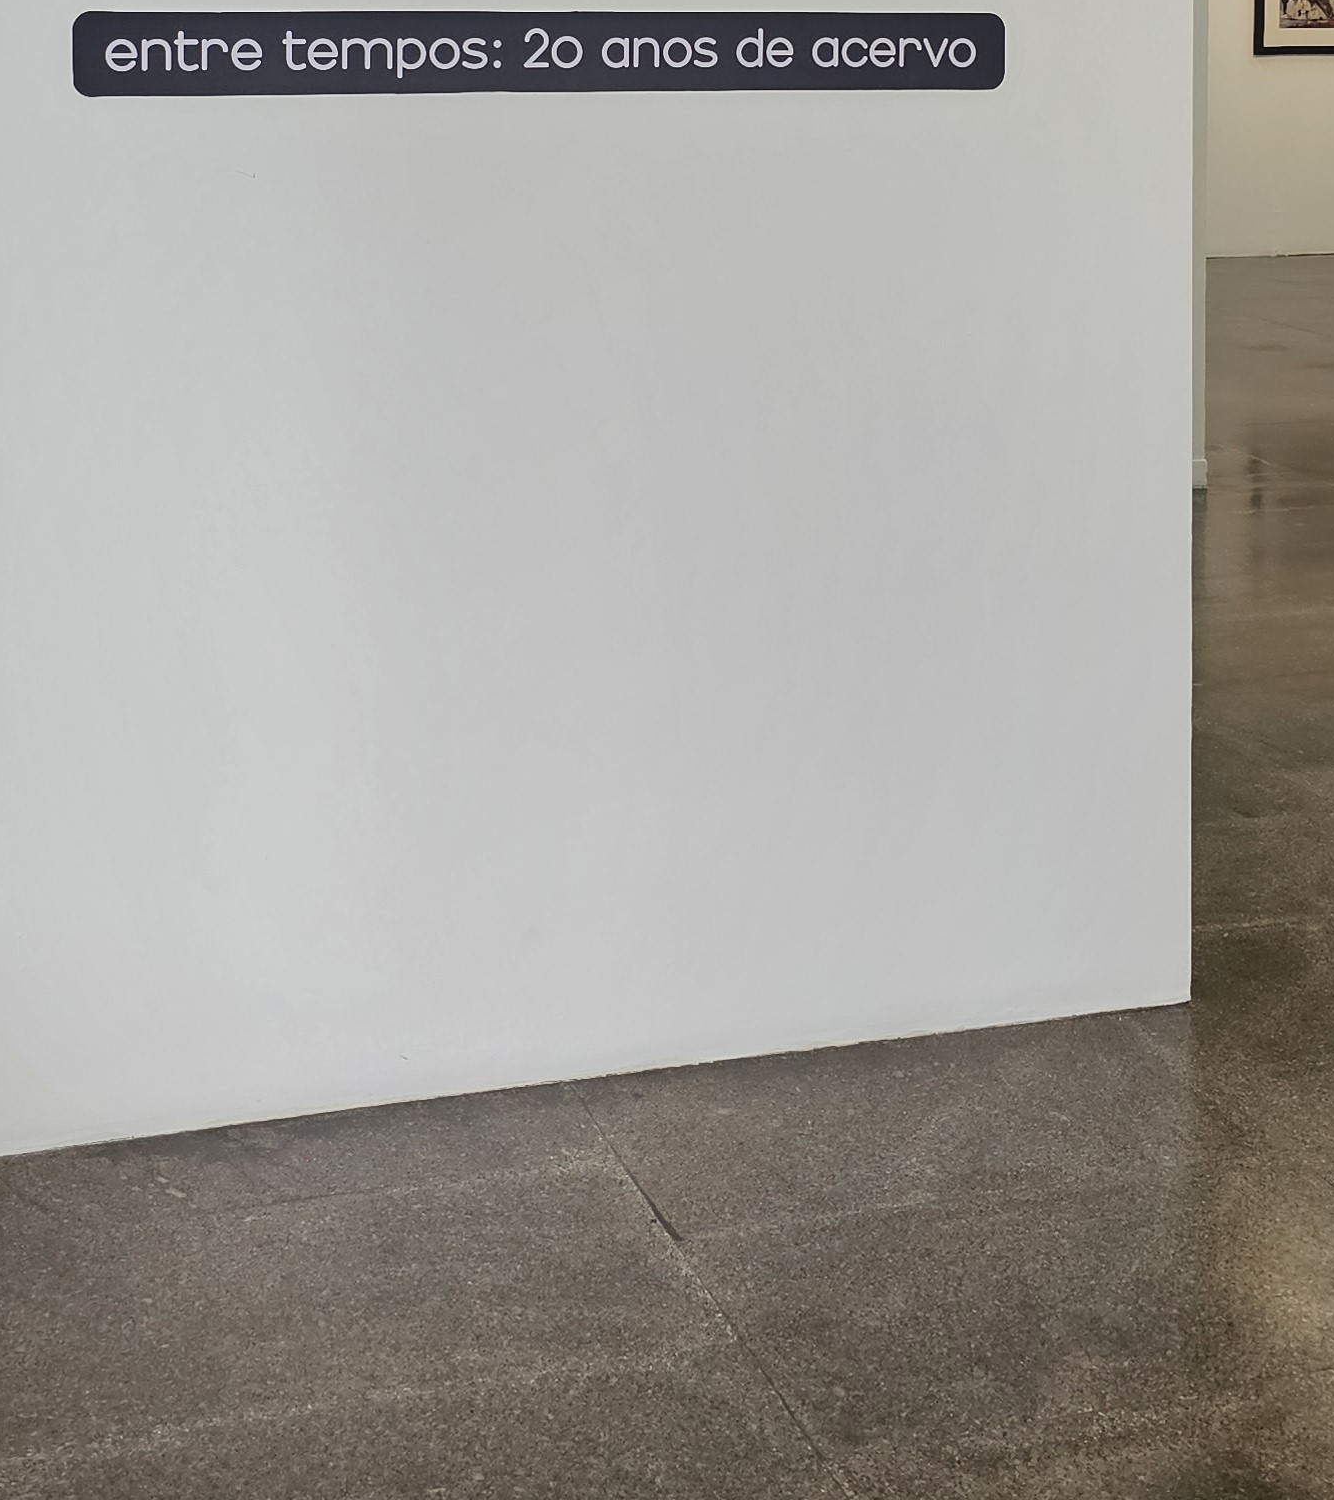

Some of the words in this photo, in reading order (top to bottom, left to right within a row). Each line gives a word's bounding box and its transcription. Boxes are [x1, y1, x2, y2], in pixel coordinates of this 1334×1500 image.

[104, 29, 264, 73] entre
[281, 29, 504, 80] tempos:
[600, 35, 720, 70] anos
[734, 26, 795, 69] de
[810, 35, 978, 69] acervo
